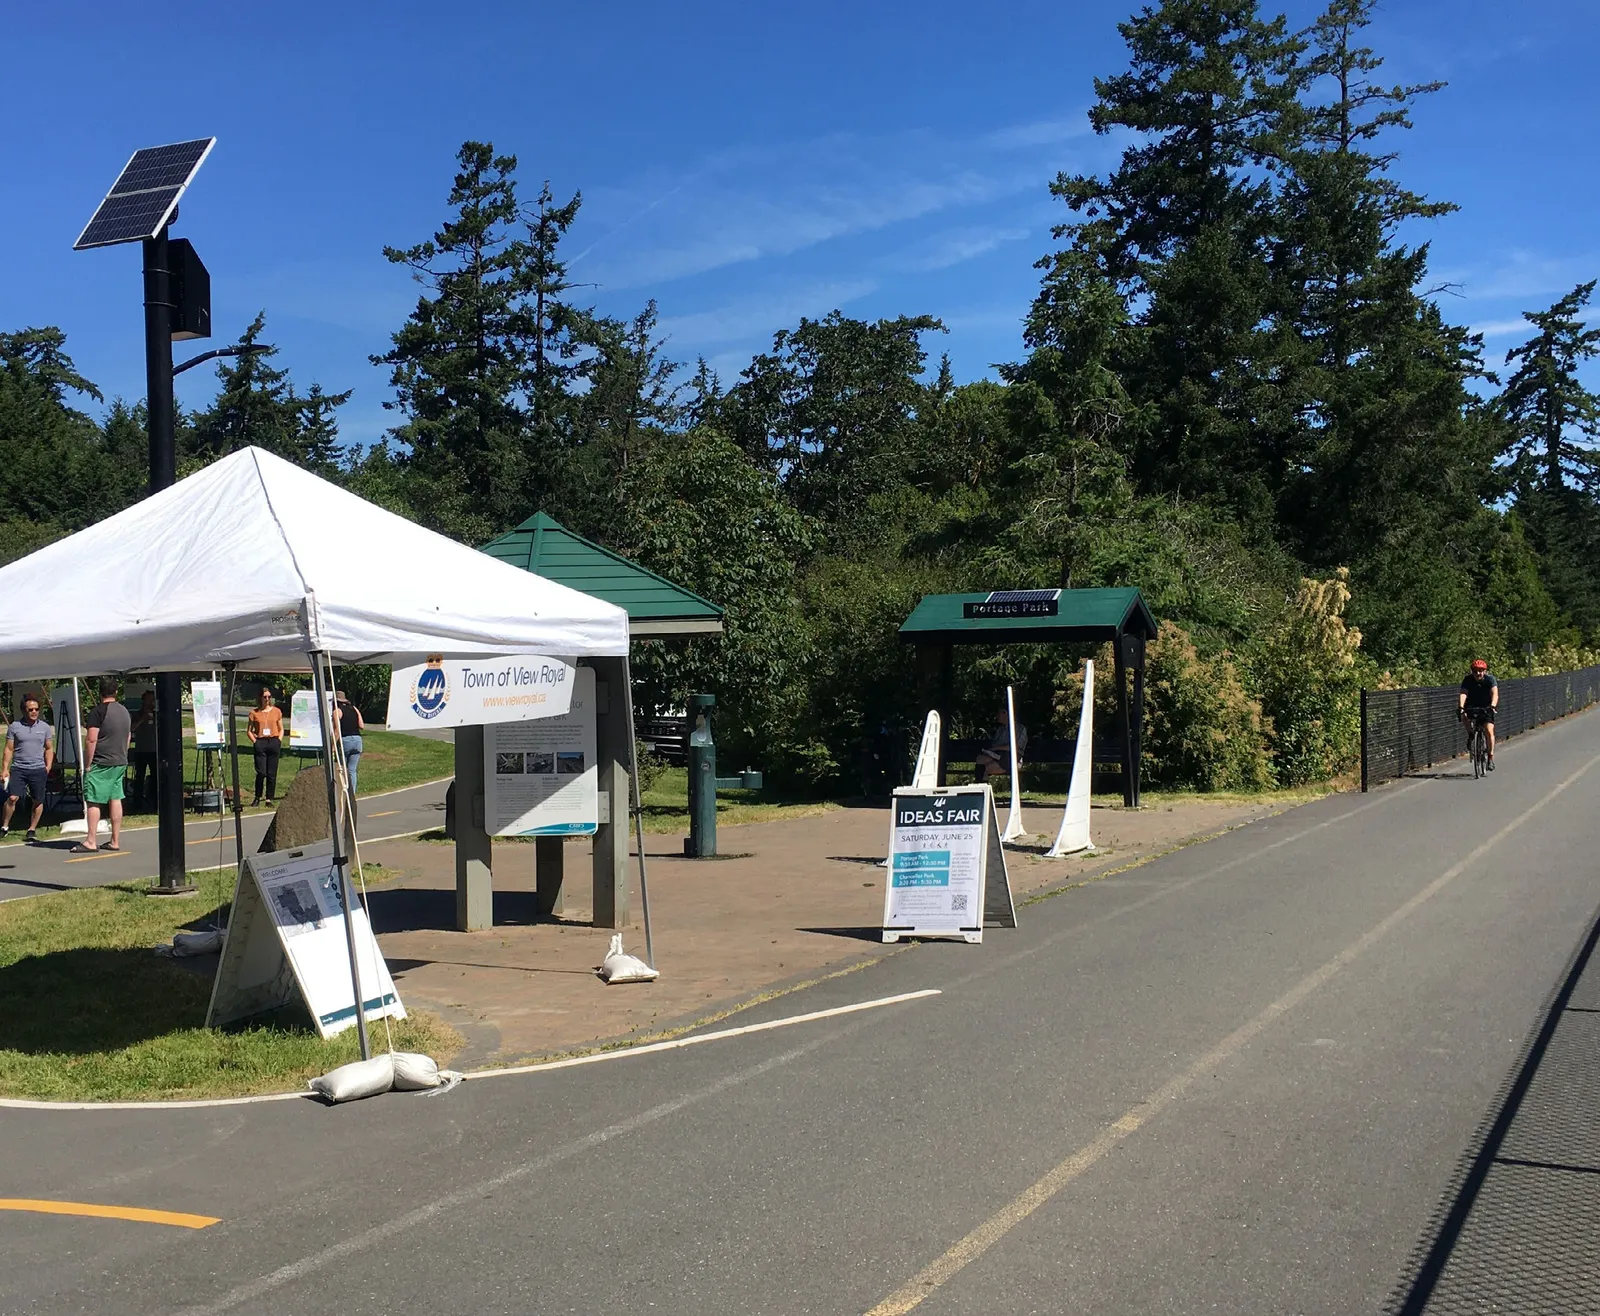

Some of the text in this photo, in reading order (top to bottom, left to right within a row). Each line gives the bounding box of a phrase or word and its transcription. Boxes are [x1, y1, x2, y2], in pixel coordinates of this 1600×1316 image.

[973, 602, 1049, 613] Portage Park
[462, 664, 567, 688] Town of View Royal
[482, 692, 547, 708] www.viewroyal.ca
[900, 809, 980, 824] IDEAS FAIR
[901, 833, 941, 843] SATURDAY,
[942, 833, 962, 841] JUNE
